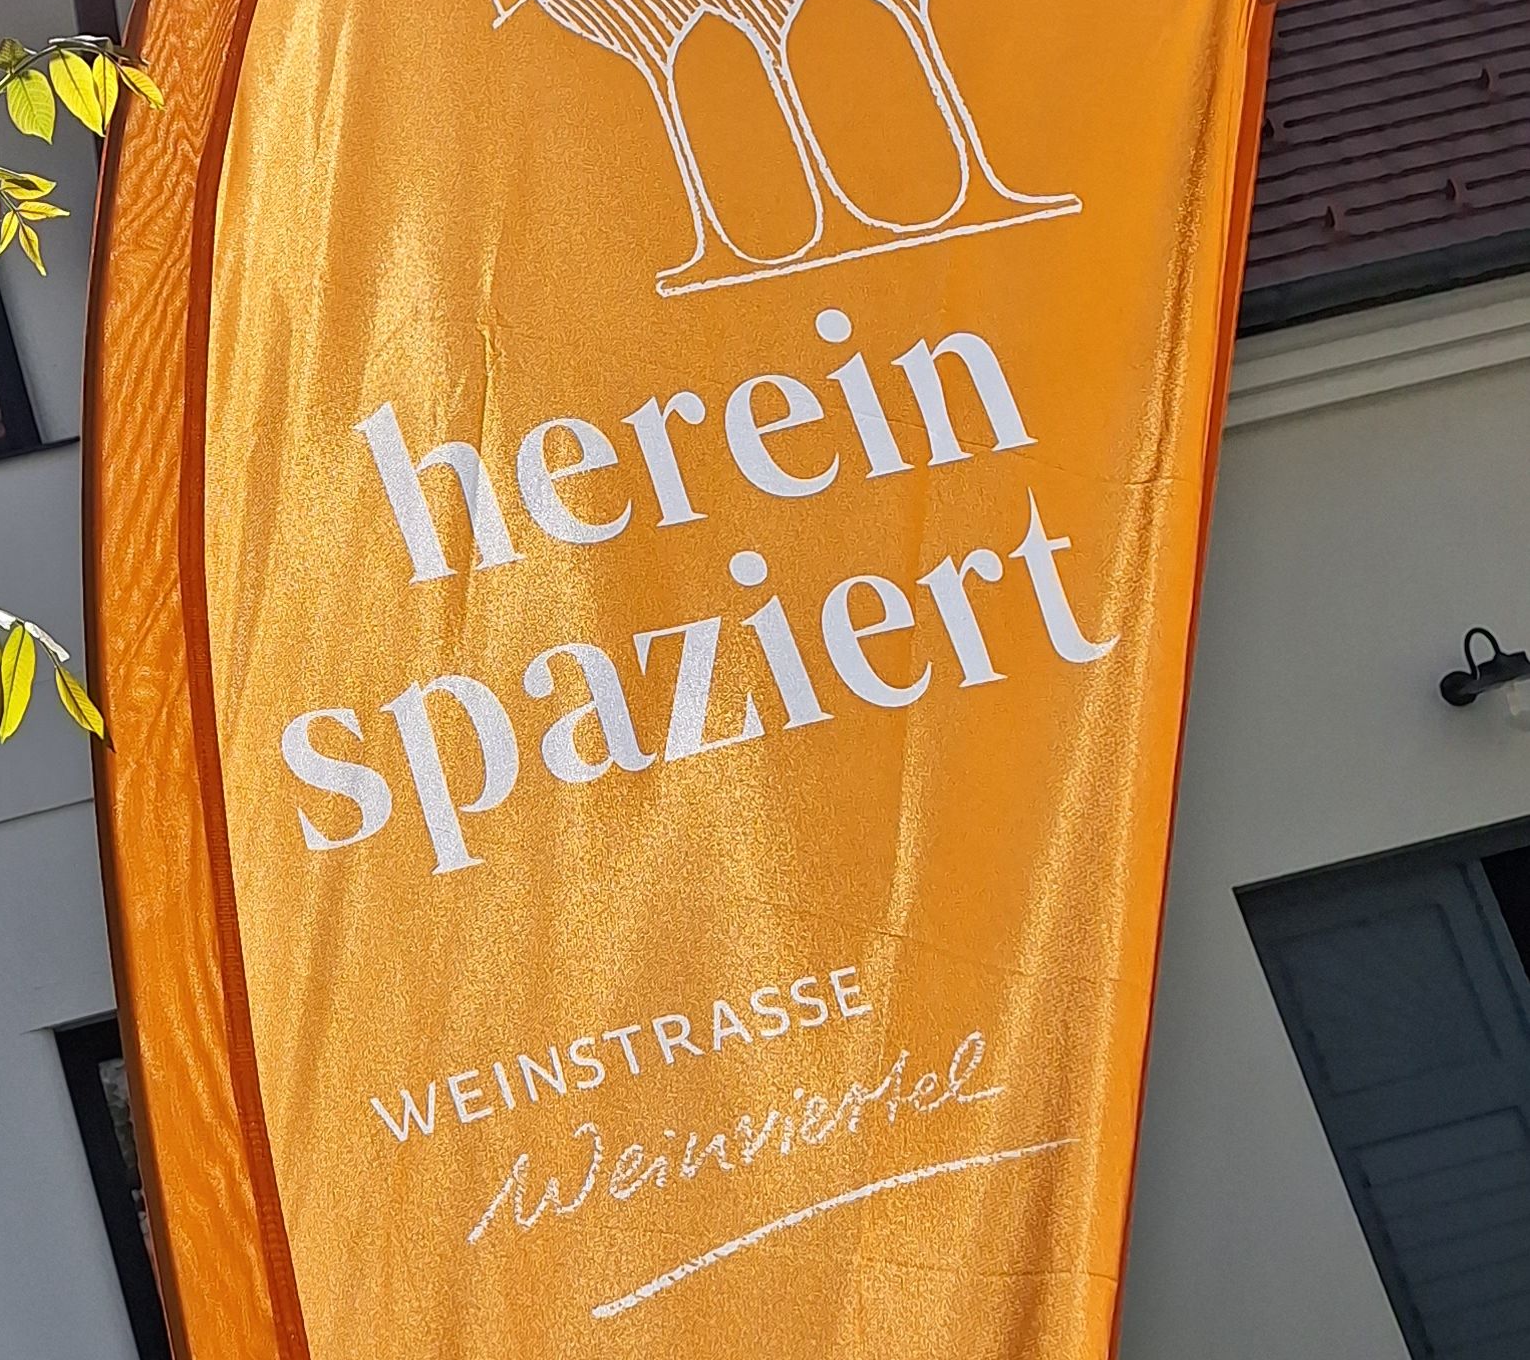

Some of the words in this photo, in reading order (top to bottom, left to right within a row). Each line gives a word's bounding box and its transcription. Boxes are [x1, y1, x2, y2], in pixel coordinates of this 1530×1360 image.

[353, 310, 1036, 586] herein
[281, 488, 1121, 875] spaziert
[370, 966, 872, 1142] WEINSTRASSE
[466, 1031, 1005, 1244] Weinviertel
